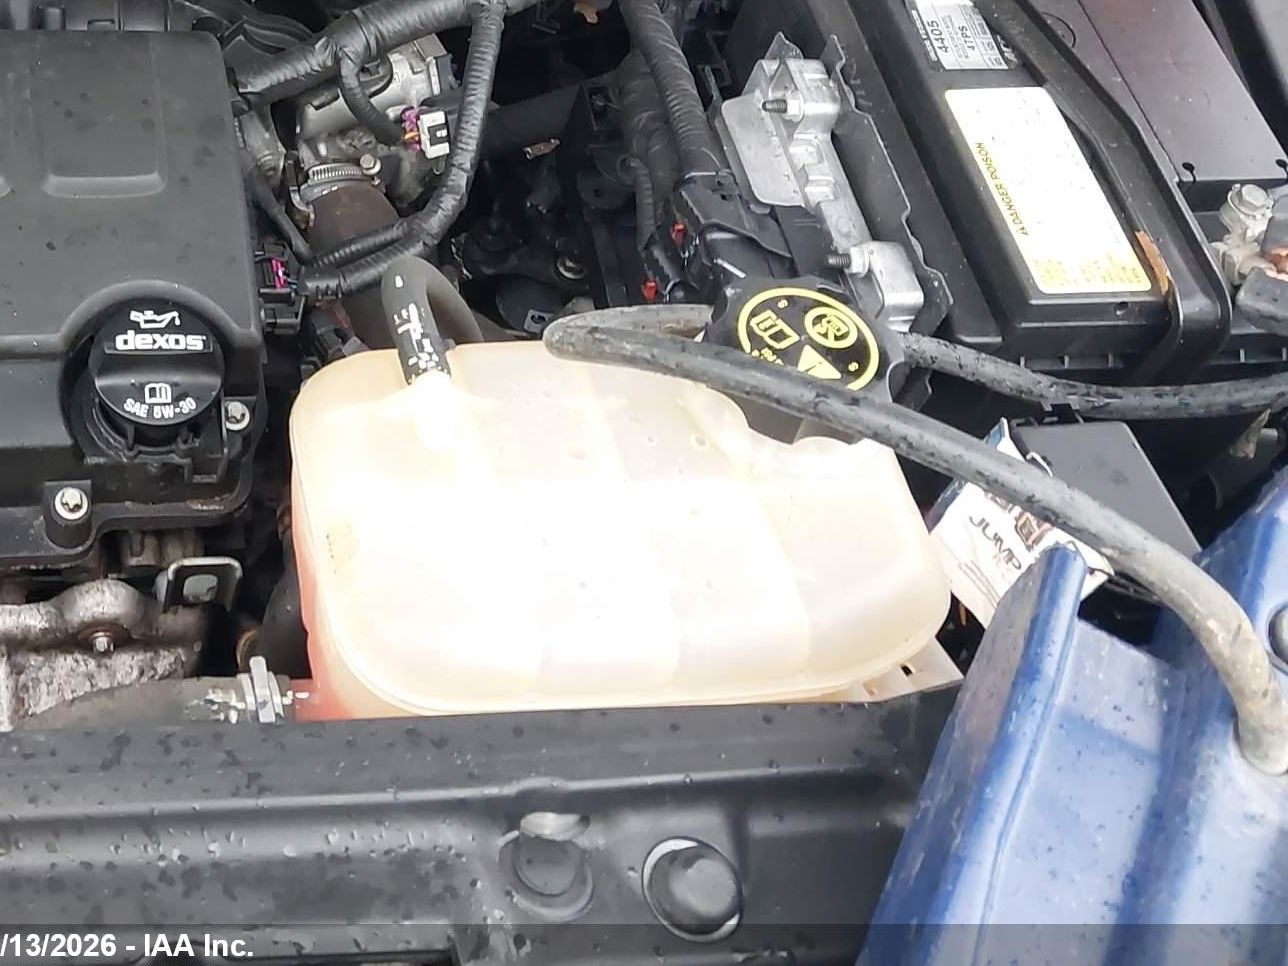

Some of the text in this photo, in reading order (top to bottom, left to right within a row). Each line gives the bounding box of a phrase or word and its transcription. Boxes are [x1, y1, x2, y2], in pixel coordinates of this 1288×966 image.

[926, 20, 949, 53] 4405
[975, 142, 1023, 226] DANGER POISON
[115, 330, 205, 351] dexos
[123, 397, 197, 419] SAE 5W-30
[969, 515, 1022, 570] JUMP
